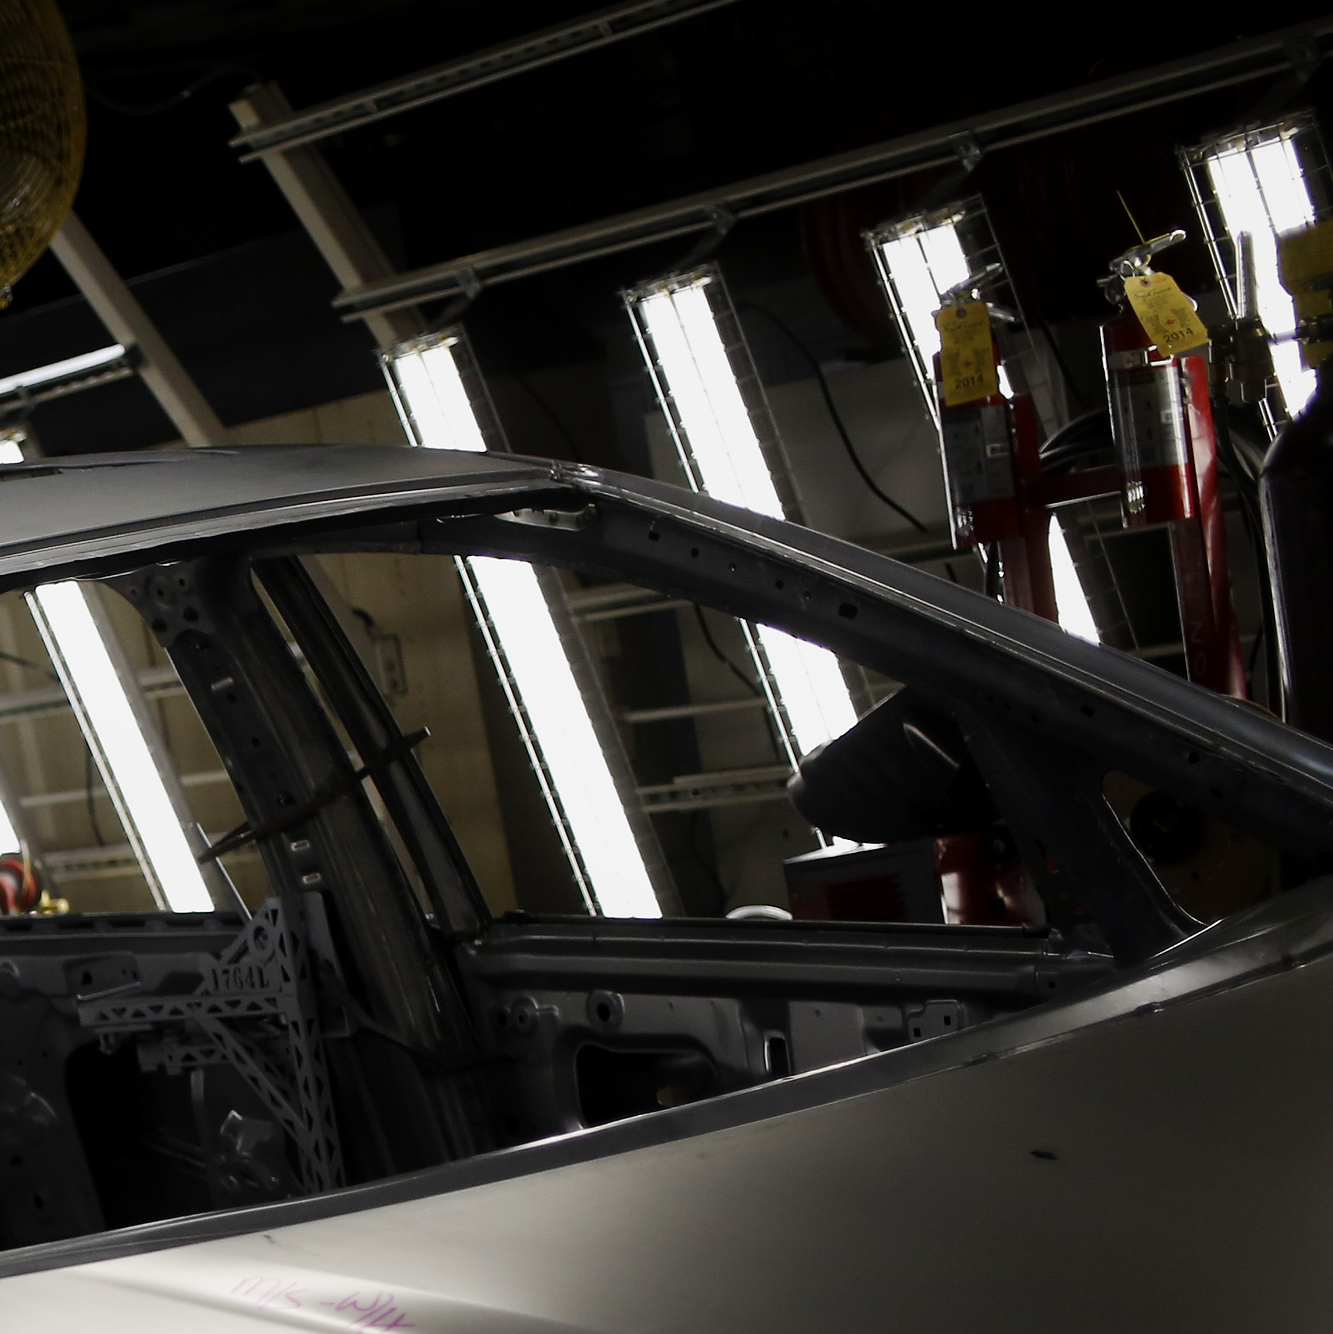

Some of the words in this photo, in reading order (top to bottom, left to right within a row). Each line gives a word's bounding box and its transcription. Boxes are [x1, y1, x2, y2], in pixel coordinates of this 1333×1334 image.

[1161, 327, 1193, 343] 2014
[955, 373, 984, 389] 2014
[211, 964, 270, 992] 1764L
